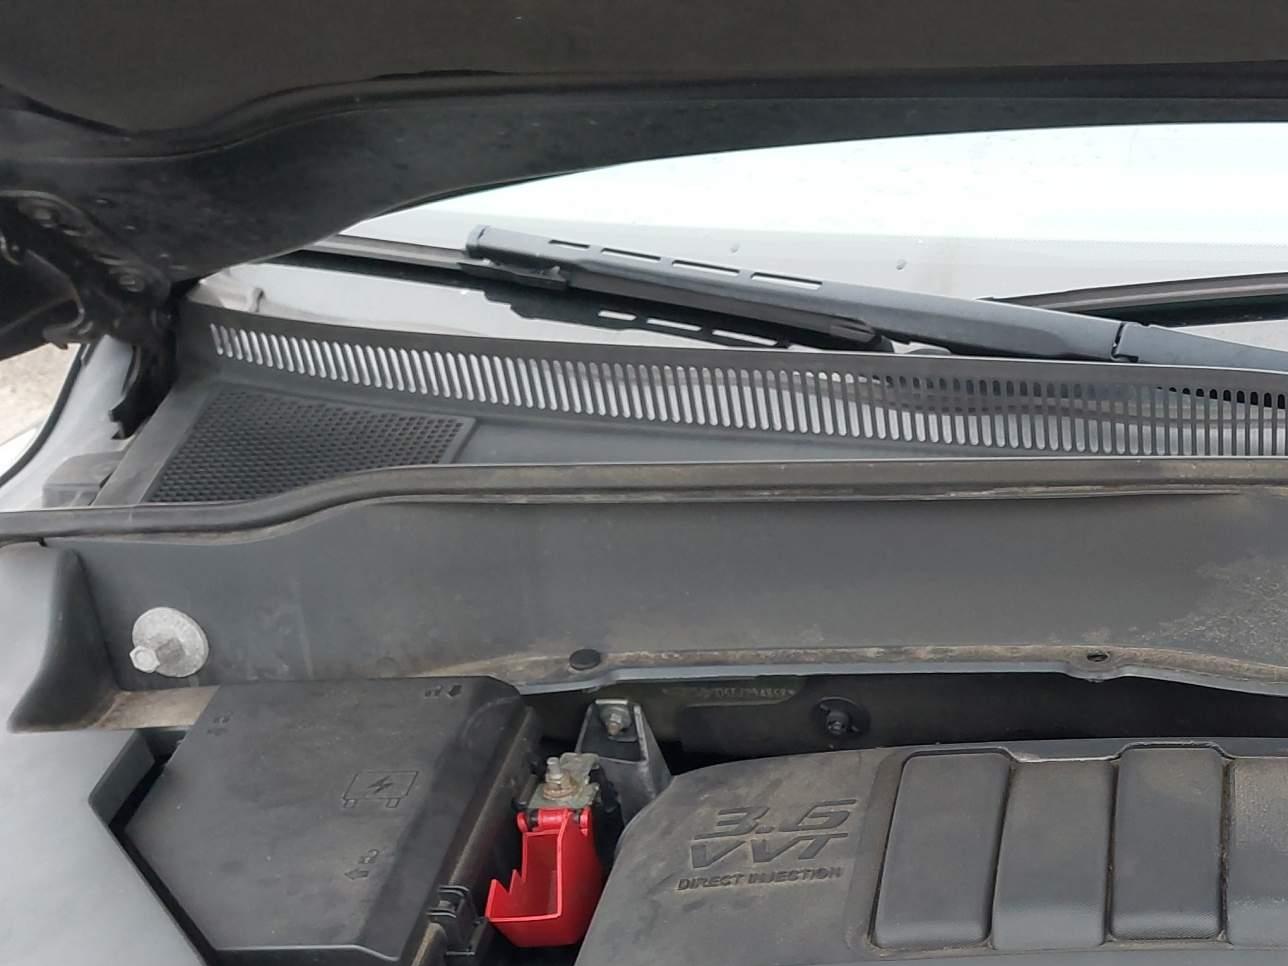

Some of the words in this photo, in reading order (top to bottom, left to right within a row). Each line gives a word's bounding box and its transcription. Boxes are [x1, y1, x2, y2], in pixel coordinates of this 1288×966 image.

[695, 799, 856, 840] 3.6
[690, 832, 849, 869] VVT
[677, 872, 745, 891] DIRECT
[750, 866, 842, 885] INJECTION
